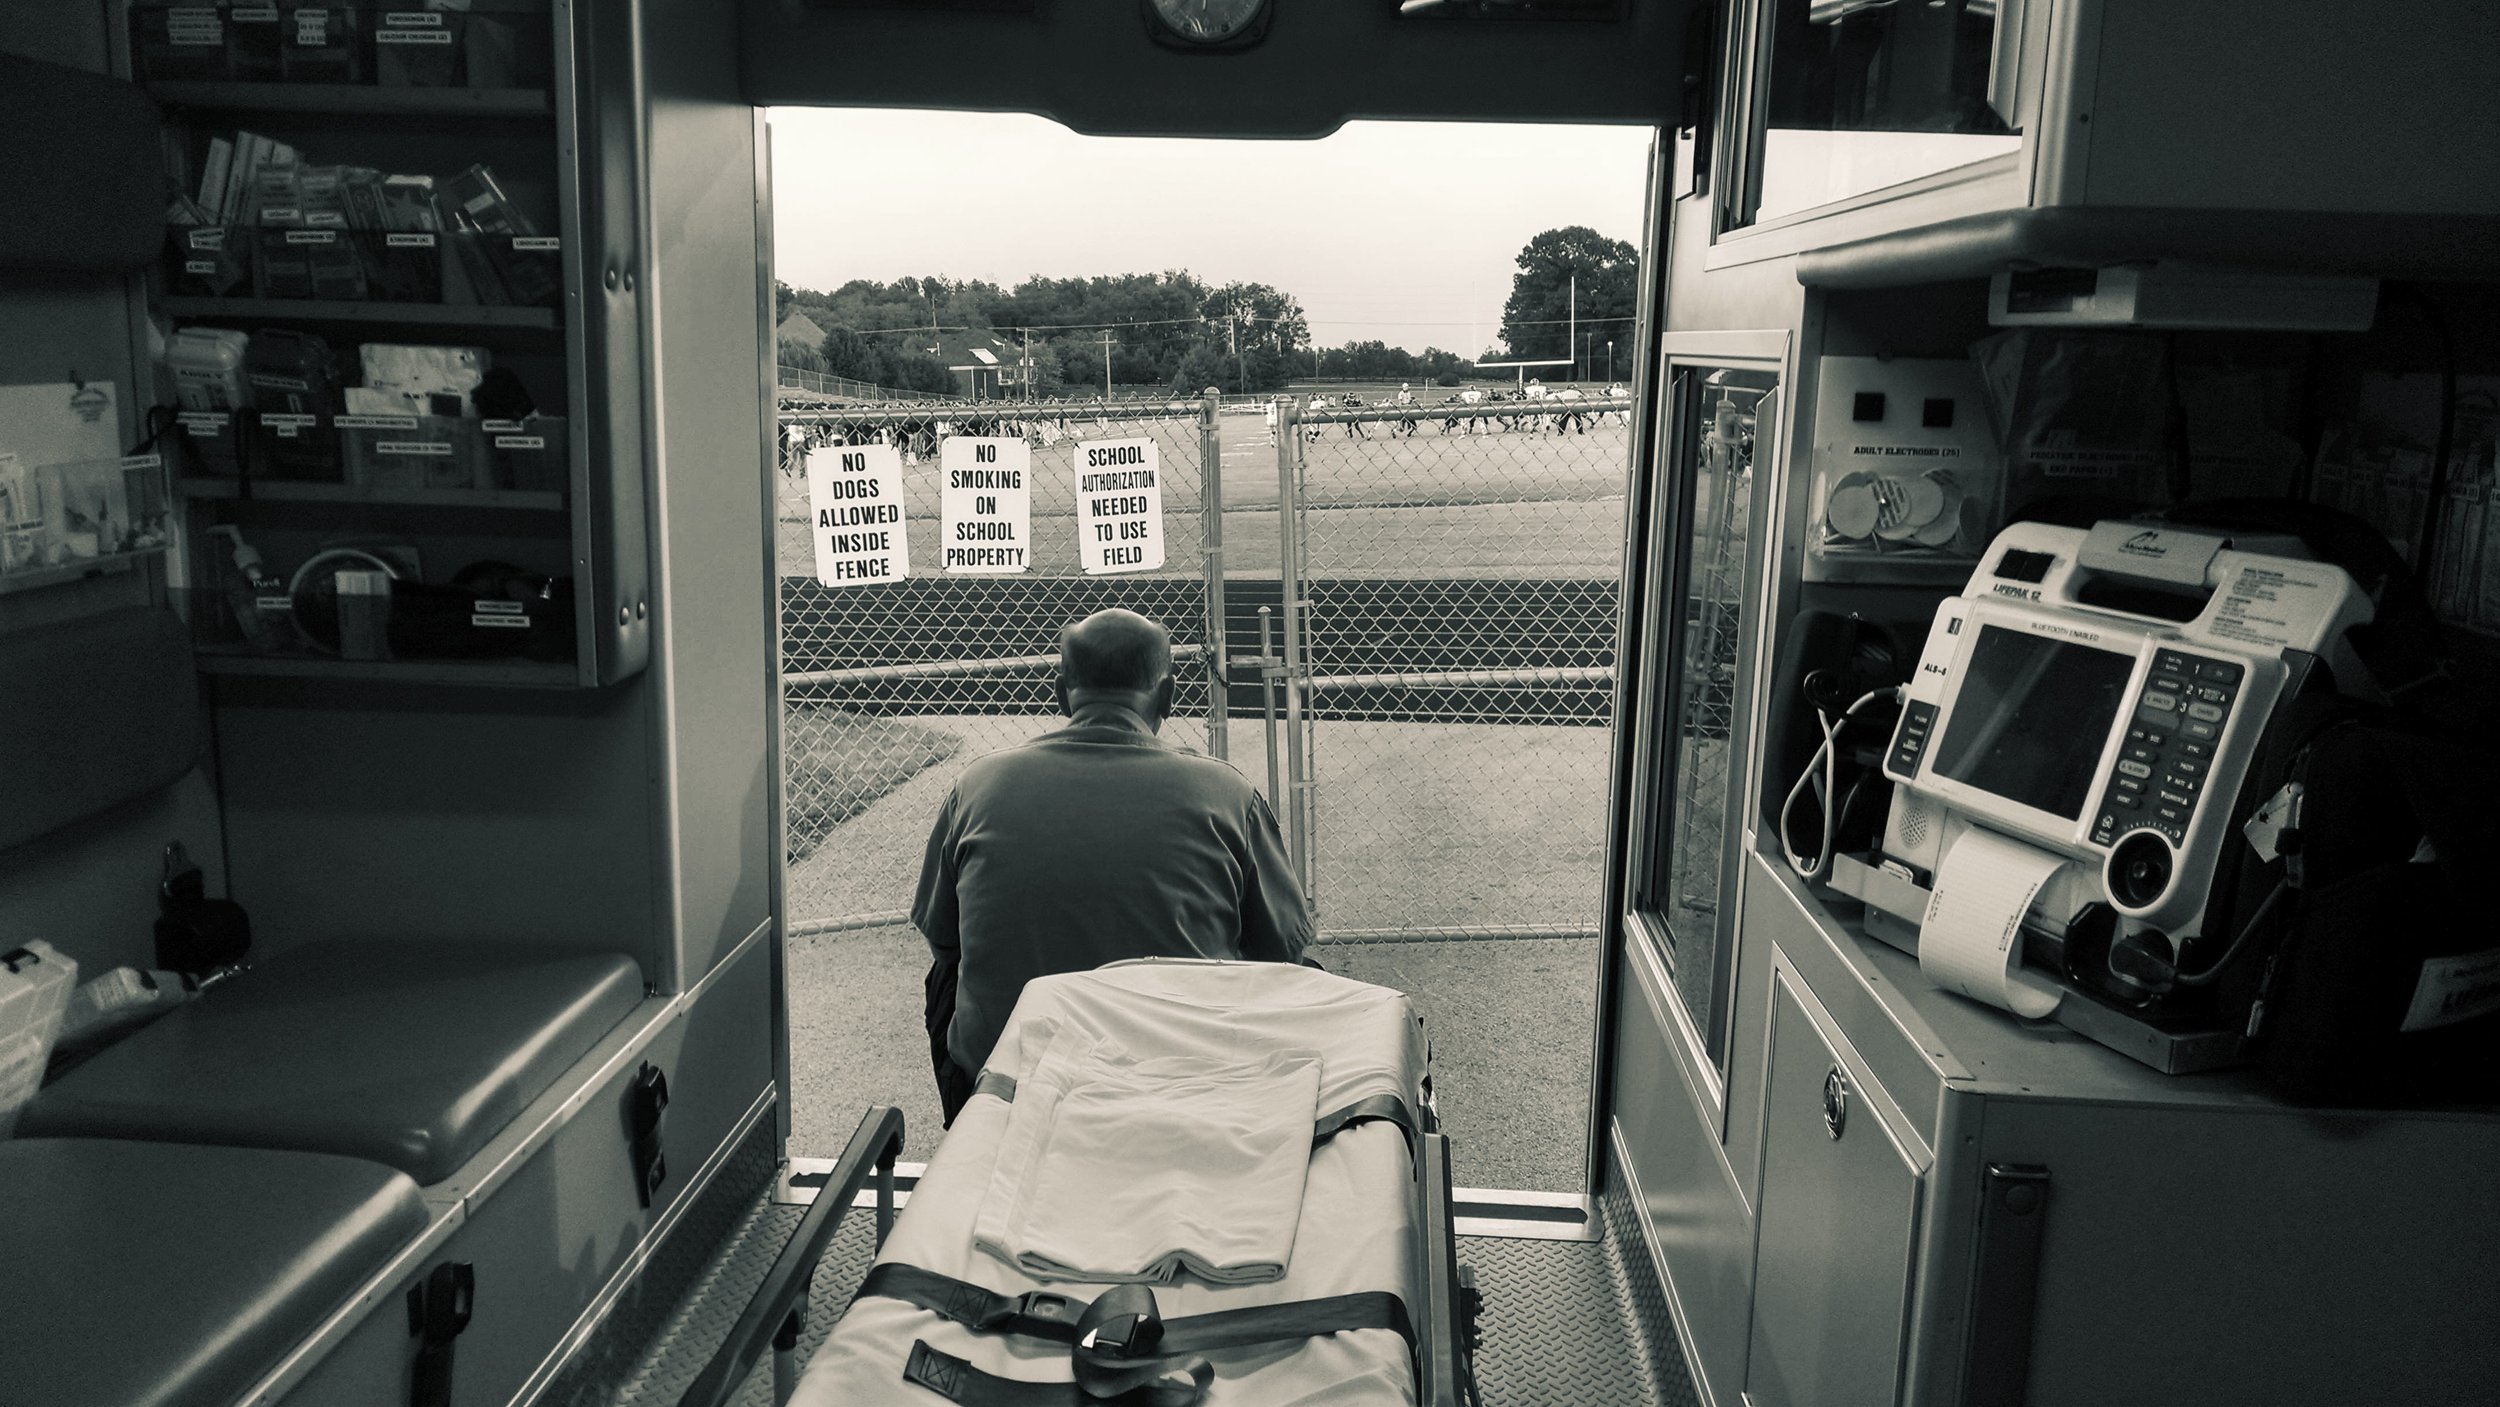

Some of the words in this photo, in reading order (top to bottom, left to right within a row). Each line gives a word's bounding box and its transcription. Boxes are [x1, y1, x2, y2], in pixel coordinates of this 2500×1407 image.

[976, 444, 996, 463] NO
[1088, 446, 1145, 467] SCHOOL
[1854, 446, 1883, 455] ADULT
[1885, 447, 1940, 456] ELECTRODES
[842, 452, 866, 473] NO
[832, 478, 879, 500] DOGS
[950, 469, 1022, 490] SMOKING
[1081, 469, 1155, 493] AUTHORIZATION
[818, 504, 899, 528] ALLOWED
[975, 496, 996, 515] ON
[1091, 496, 1148, 518] NEEDED
[956, 522, 1015, 542] SCHOOL
[1095, 522, 1114, 542] TO
[1120, 521, 1148, 540] USE
[831, 531, 891, 554] INSIDE
[947, 547, 1024, 567] PROPERTY
[1103, 546, 1143, 567] FIELD
[835, 557, 891, 580] FENCE
[1993, 583, 2029, 600] LIFEPAK
[2031, 622, 2069, 636] BLUETOOTH
[2069, 629, 2100, 642] ENABLED
[2186, 683, 2194, 695] 2
[2179, 701, 2187, 713] 3
